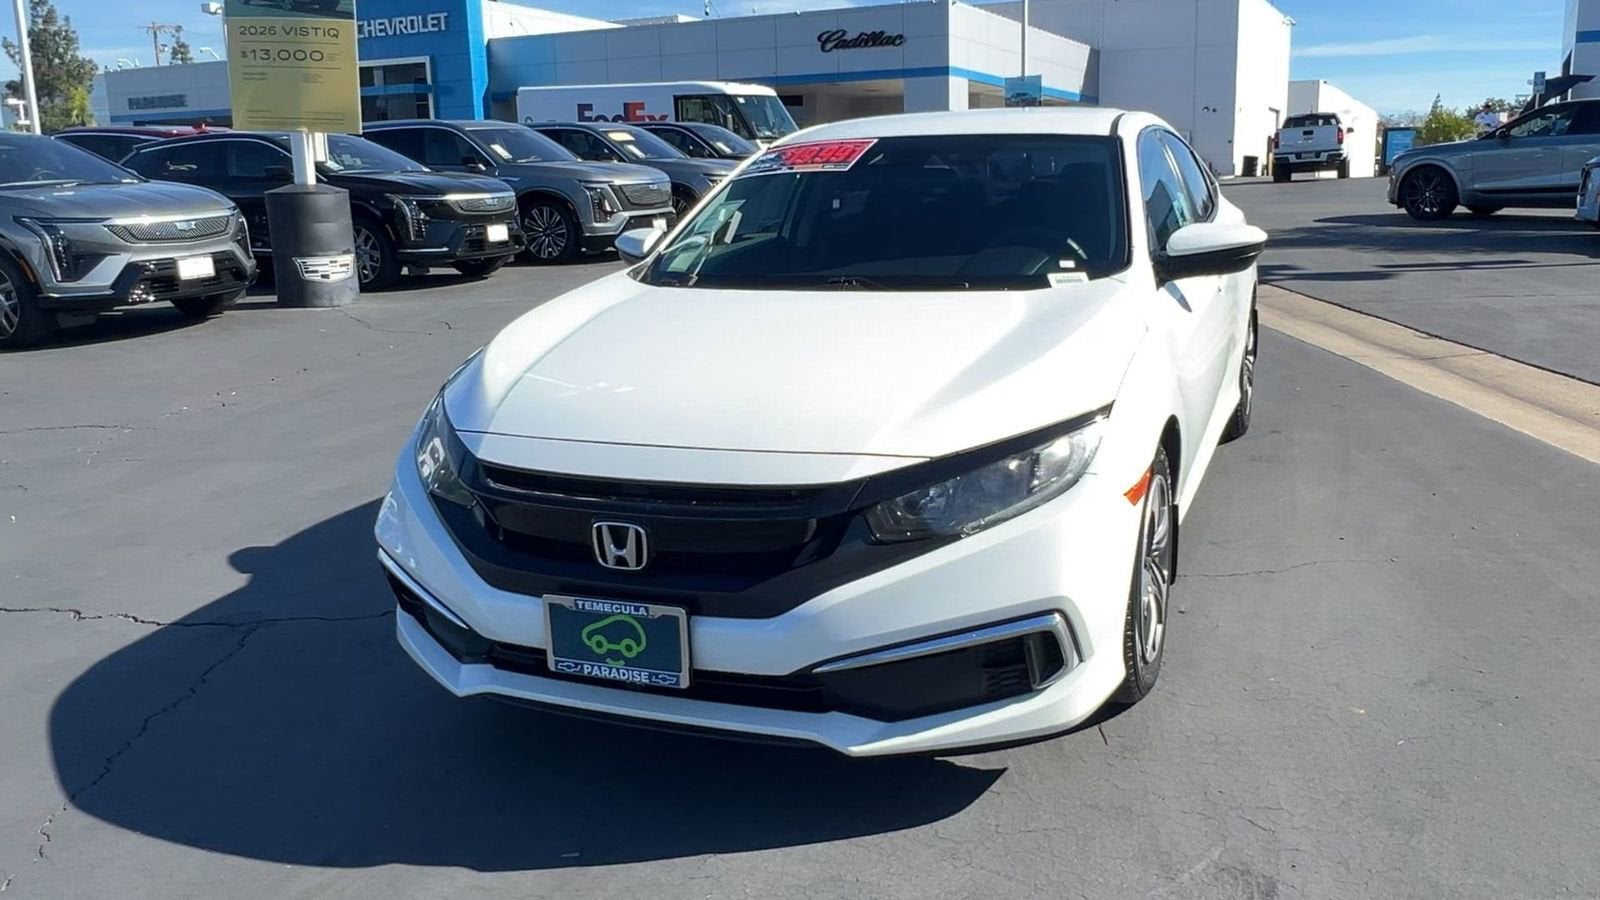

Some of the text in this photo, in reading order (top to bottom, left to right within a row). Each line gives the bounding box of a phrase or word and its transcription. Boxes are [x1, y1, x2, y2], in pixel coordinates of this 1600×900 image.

[239, 25, 340, 39] 2026 VISTIQ
[816, 28, 907, 53] Cadillac
[241, 48, 325, 62] $13,000
[575, 600, 648, 616] TEMECULA
[583, 664, 650, 683] PARADISE
